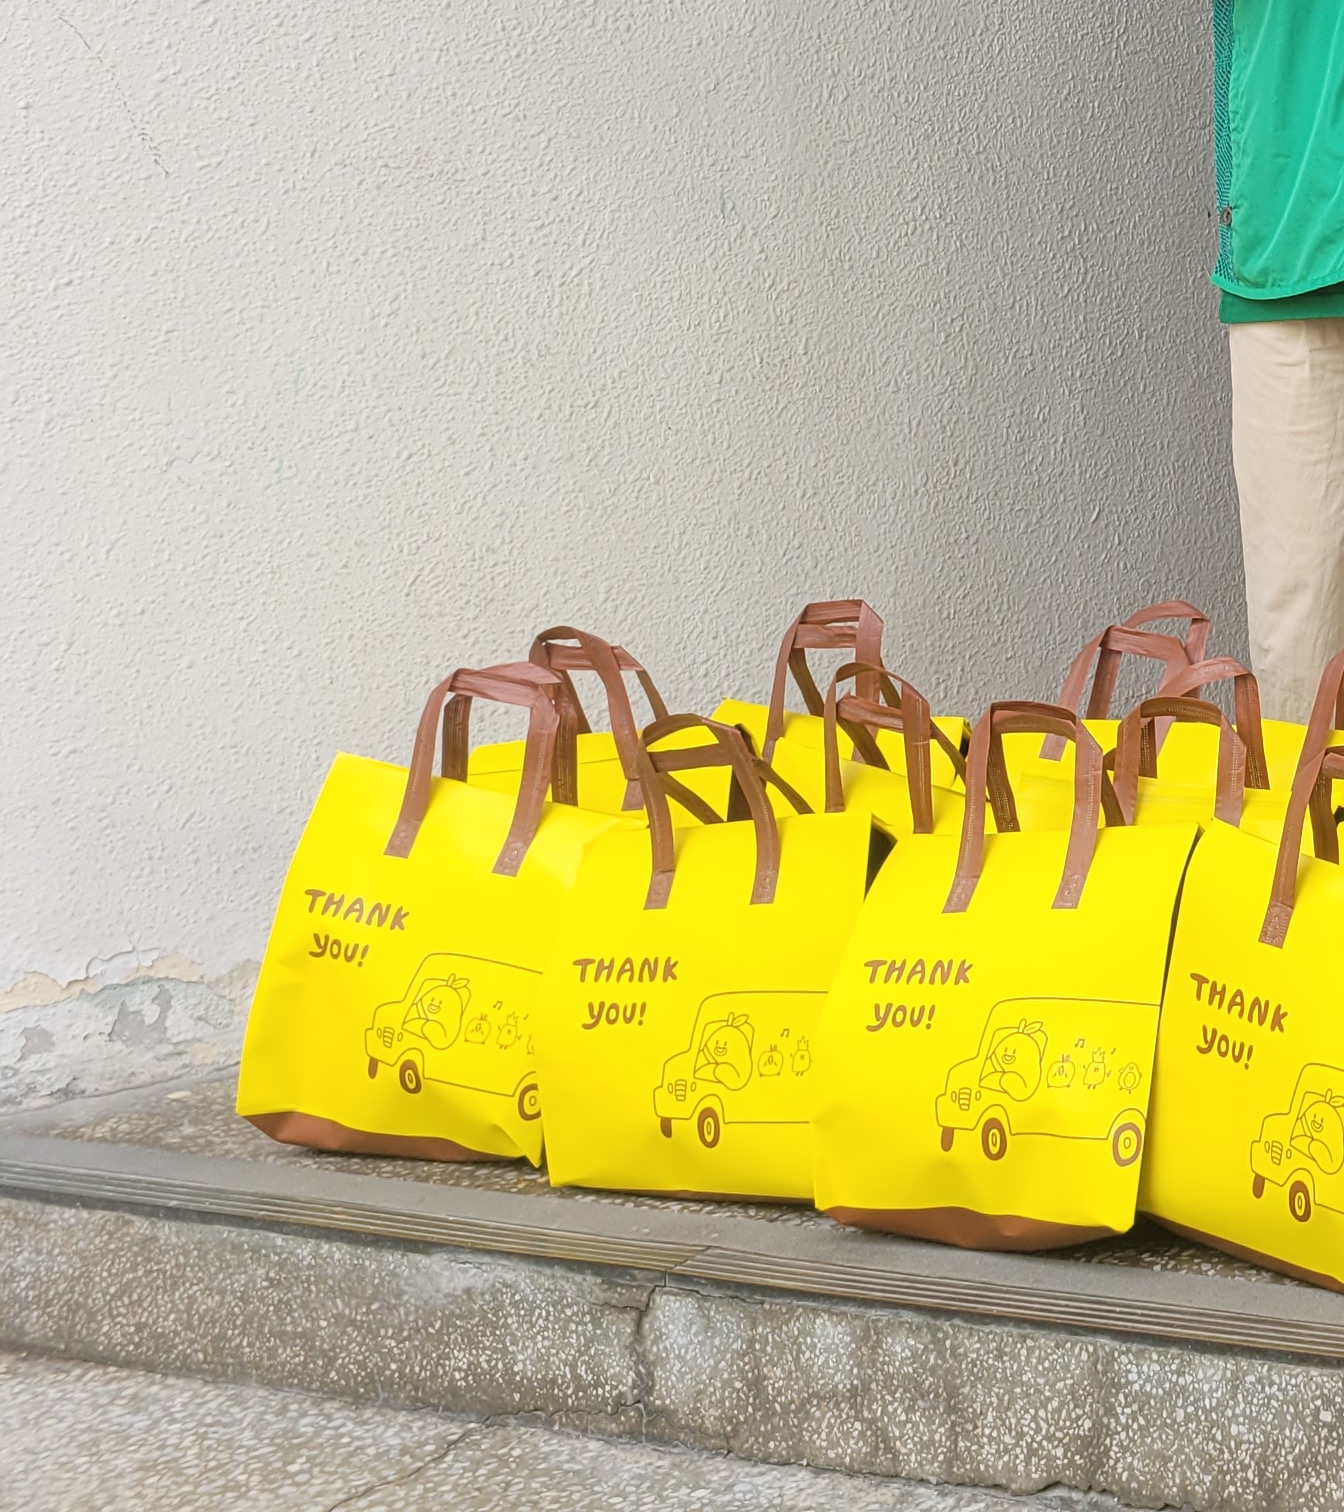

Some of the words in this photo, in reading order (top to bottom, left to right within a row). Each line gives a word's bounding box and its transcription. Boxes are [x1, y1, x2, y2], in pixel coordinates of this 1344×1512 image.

[303, 888, 410, 932] THANK
[573, 955, 679, 984] THANK
[863, 958, 974, 987] THANK
[1189, 971, 1290, 1034] THANK
